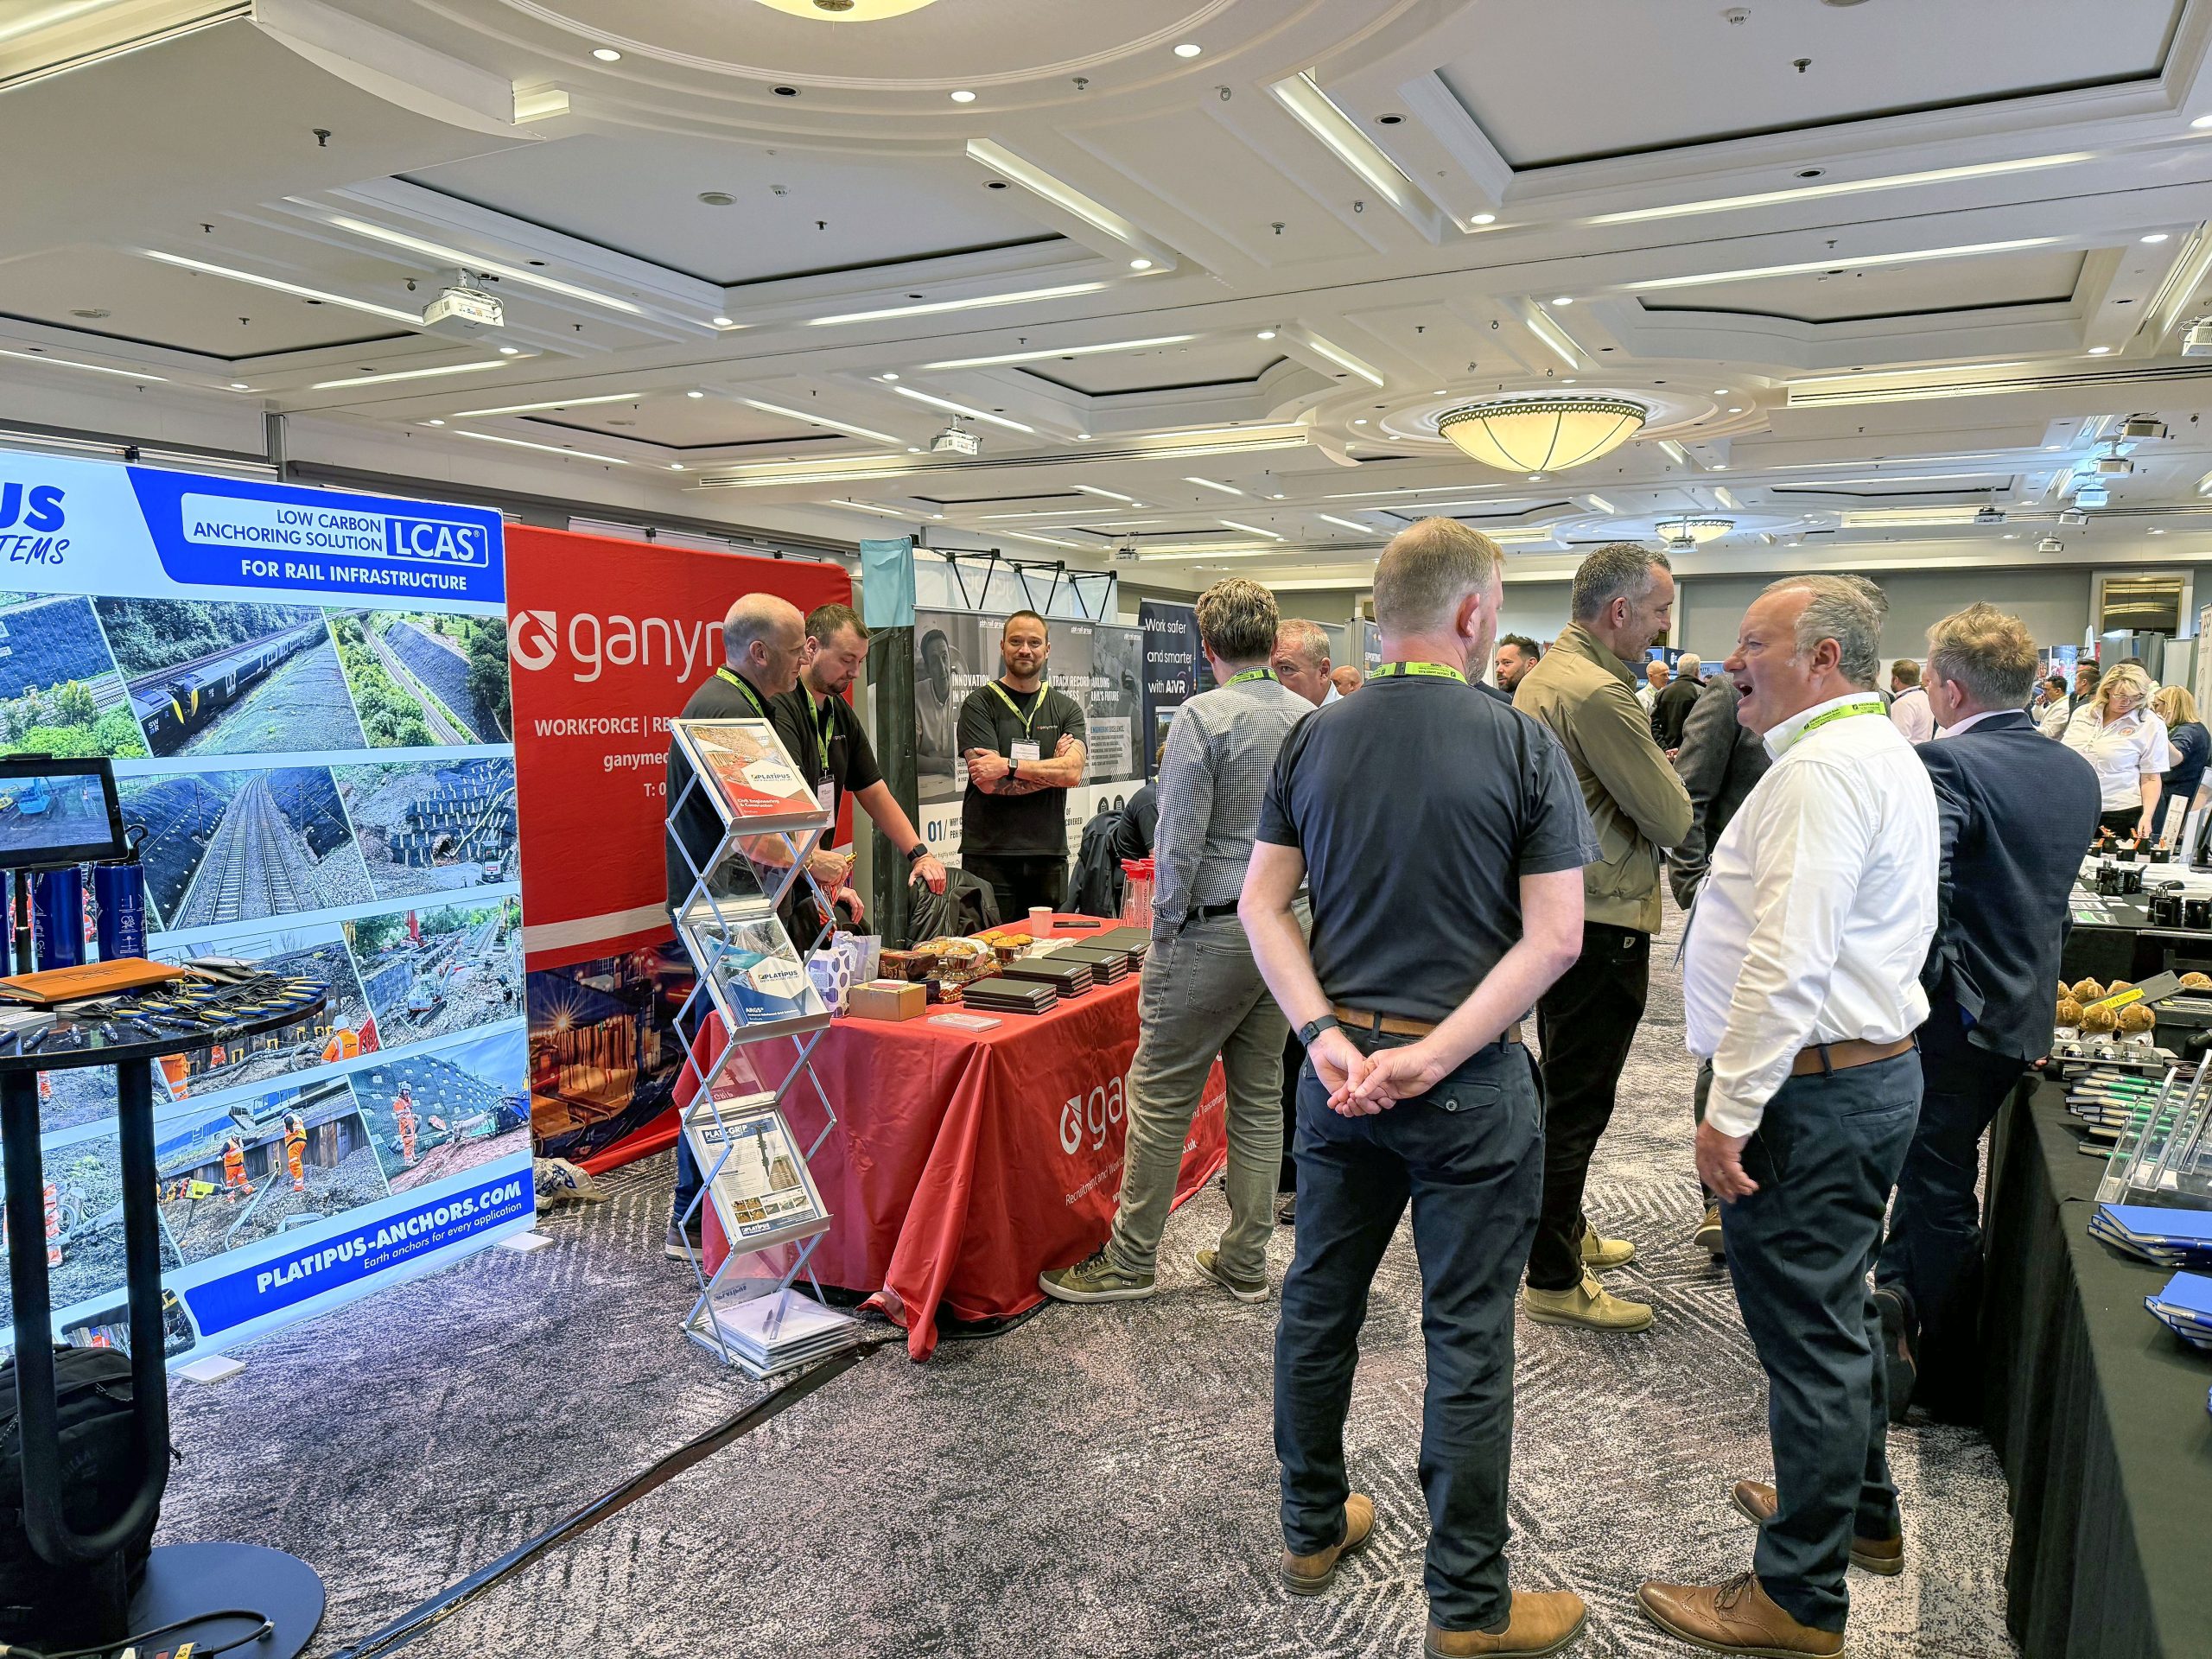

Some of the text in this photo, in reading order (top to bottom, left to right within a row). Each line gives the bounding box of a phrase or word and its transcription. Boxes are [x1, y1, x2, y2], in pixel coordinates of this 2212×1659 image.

[276, 509, 382, 533] LOW CARBON
[194, 521, 383, 551] ANCHORING SOLUTION
[241, 559, 467, 591] FOR RAIL INFRASTRUCTURE
[1145, 618, 1186, 634] Work safer
[1147, 650, 1164, 663] and
[1164, 651, 1192, 664] smarter
[951, 674, 990, 687] INNOVATION
[1052, 676, 1069, 687] TRACK
[1147, 678, 1165, 693] with
[952, 690, 959, 702] IN
[534, 717, 639, 737] WORKFORCE
[644, 783, 655, 797] T:
[1065, 1176, 1097, 1207] Recruitment
[1097, 1166, 1109, 1184] and
[1109, 1155, 1124, 1179] Workfo
[256, 1180, 522, 1294] PLATIPUS-ANCHORS.COM
[364, 1201, 522, 1269] Earth anchors for every application
